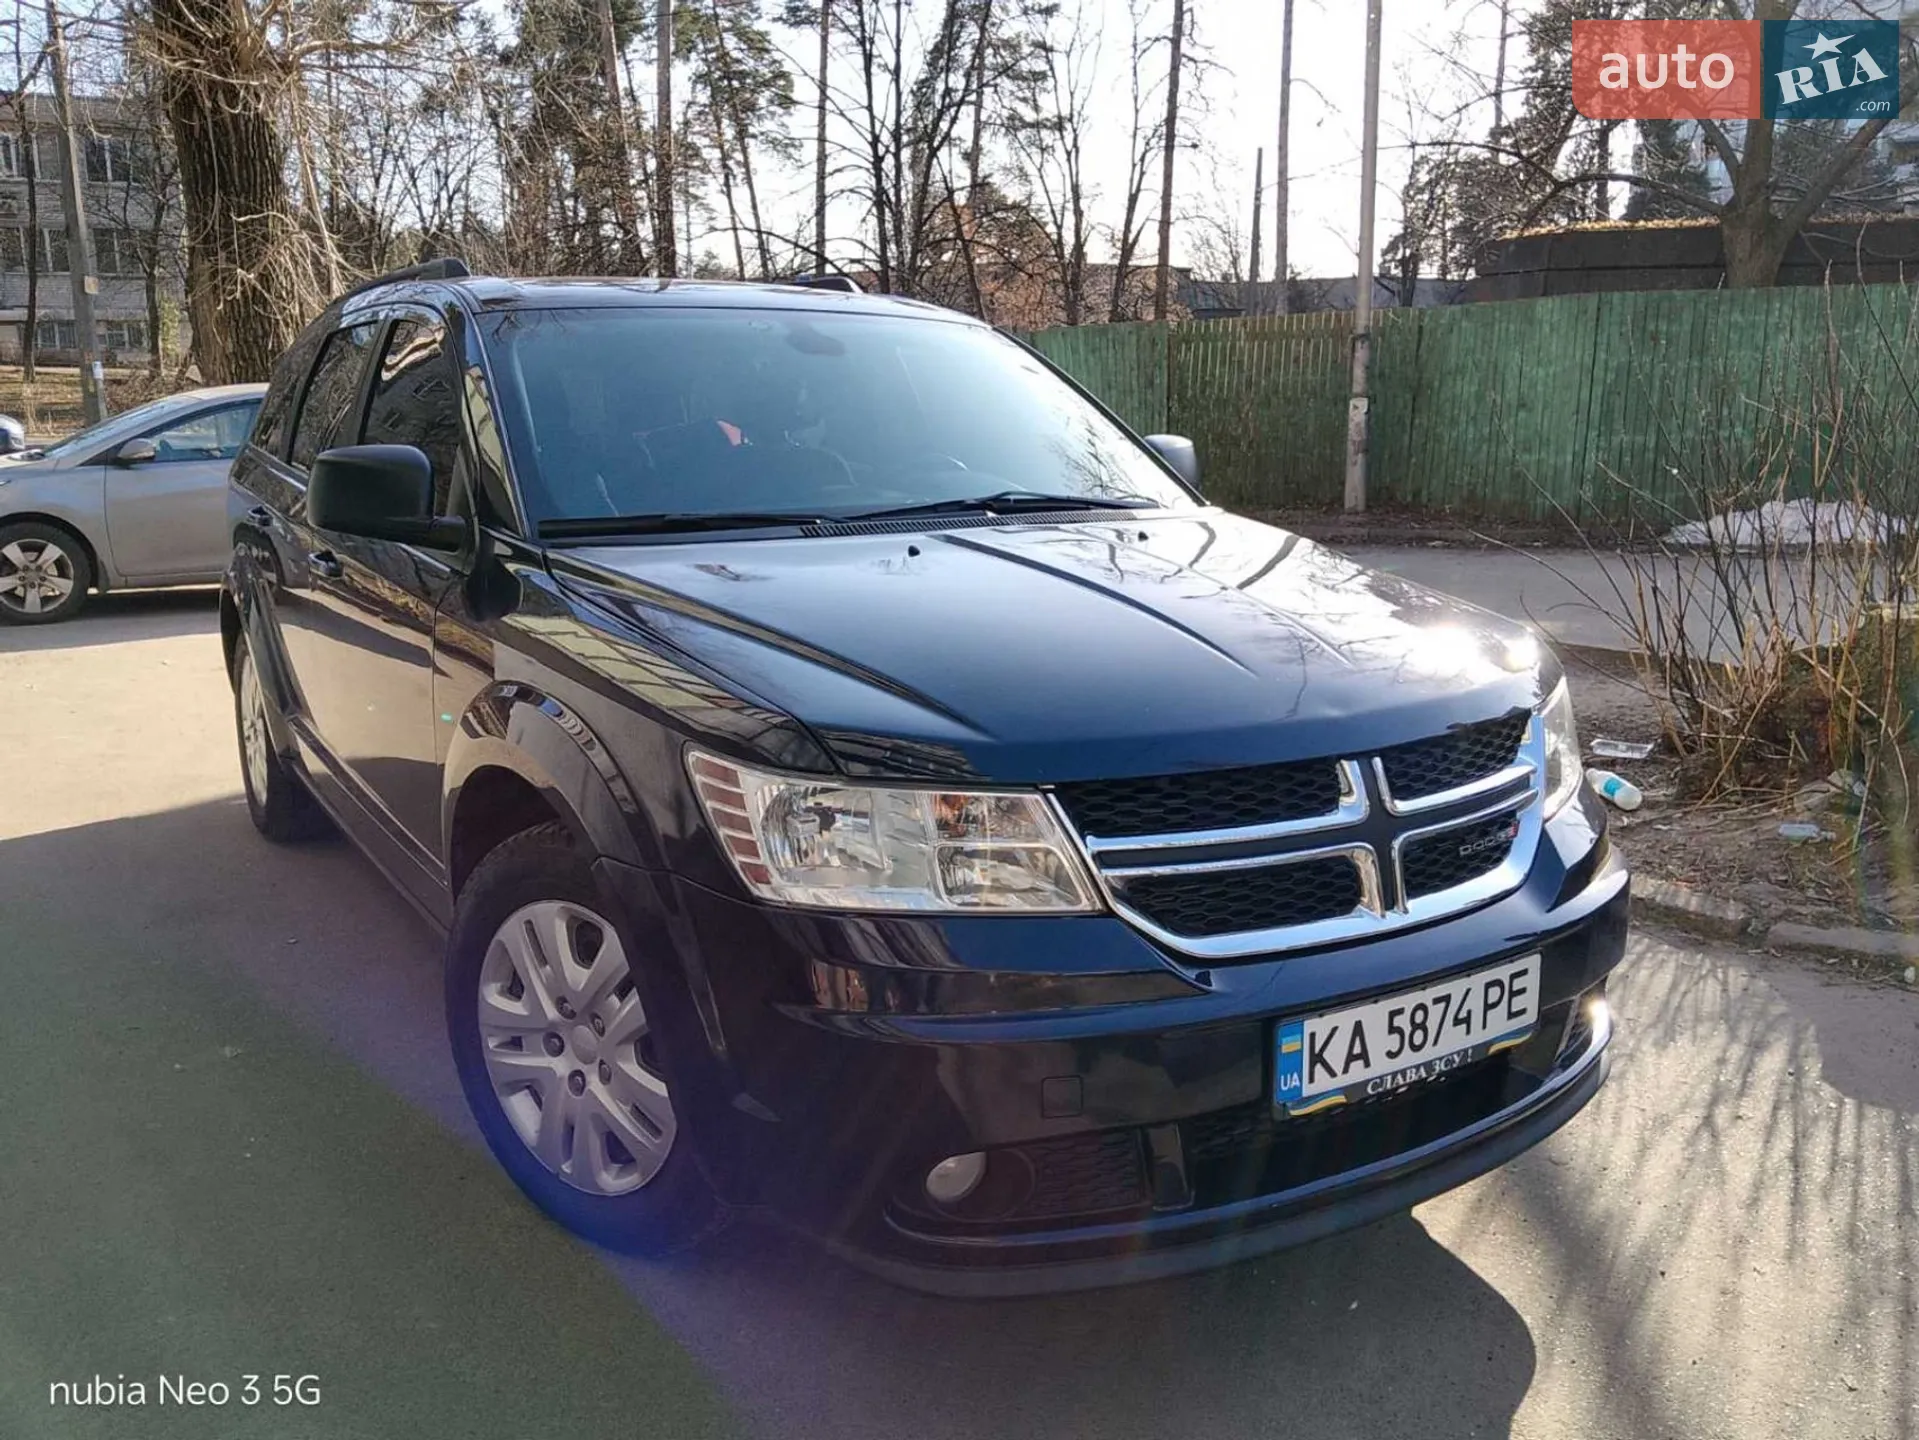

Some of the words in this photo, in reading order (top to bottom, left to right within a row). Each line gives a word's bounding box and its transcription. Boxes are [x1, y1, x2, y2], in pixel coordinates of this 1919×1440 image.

[1307, 1020, 1371, 1084] KA
[1385, 987, 1472, 1060] 5874
[1281, 1072, 1300, 1090] UA
[1366, 1065, 1428, 1095] СЛАВА
